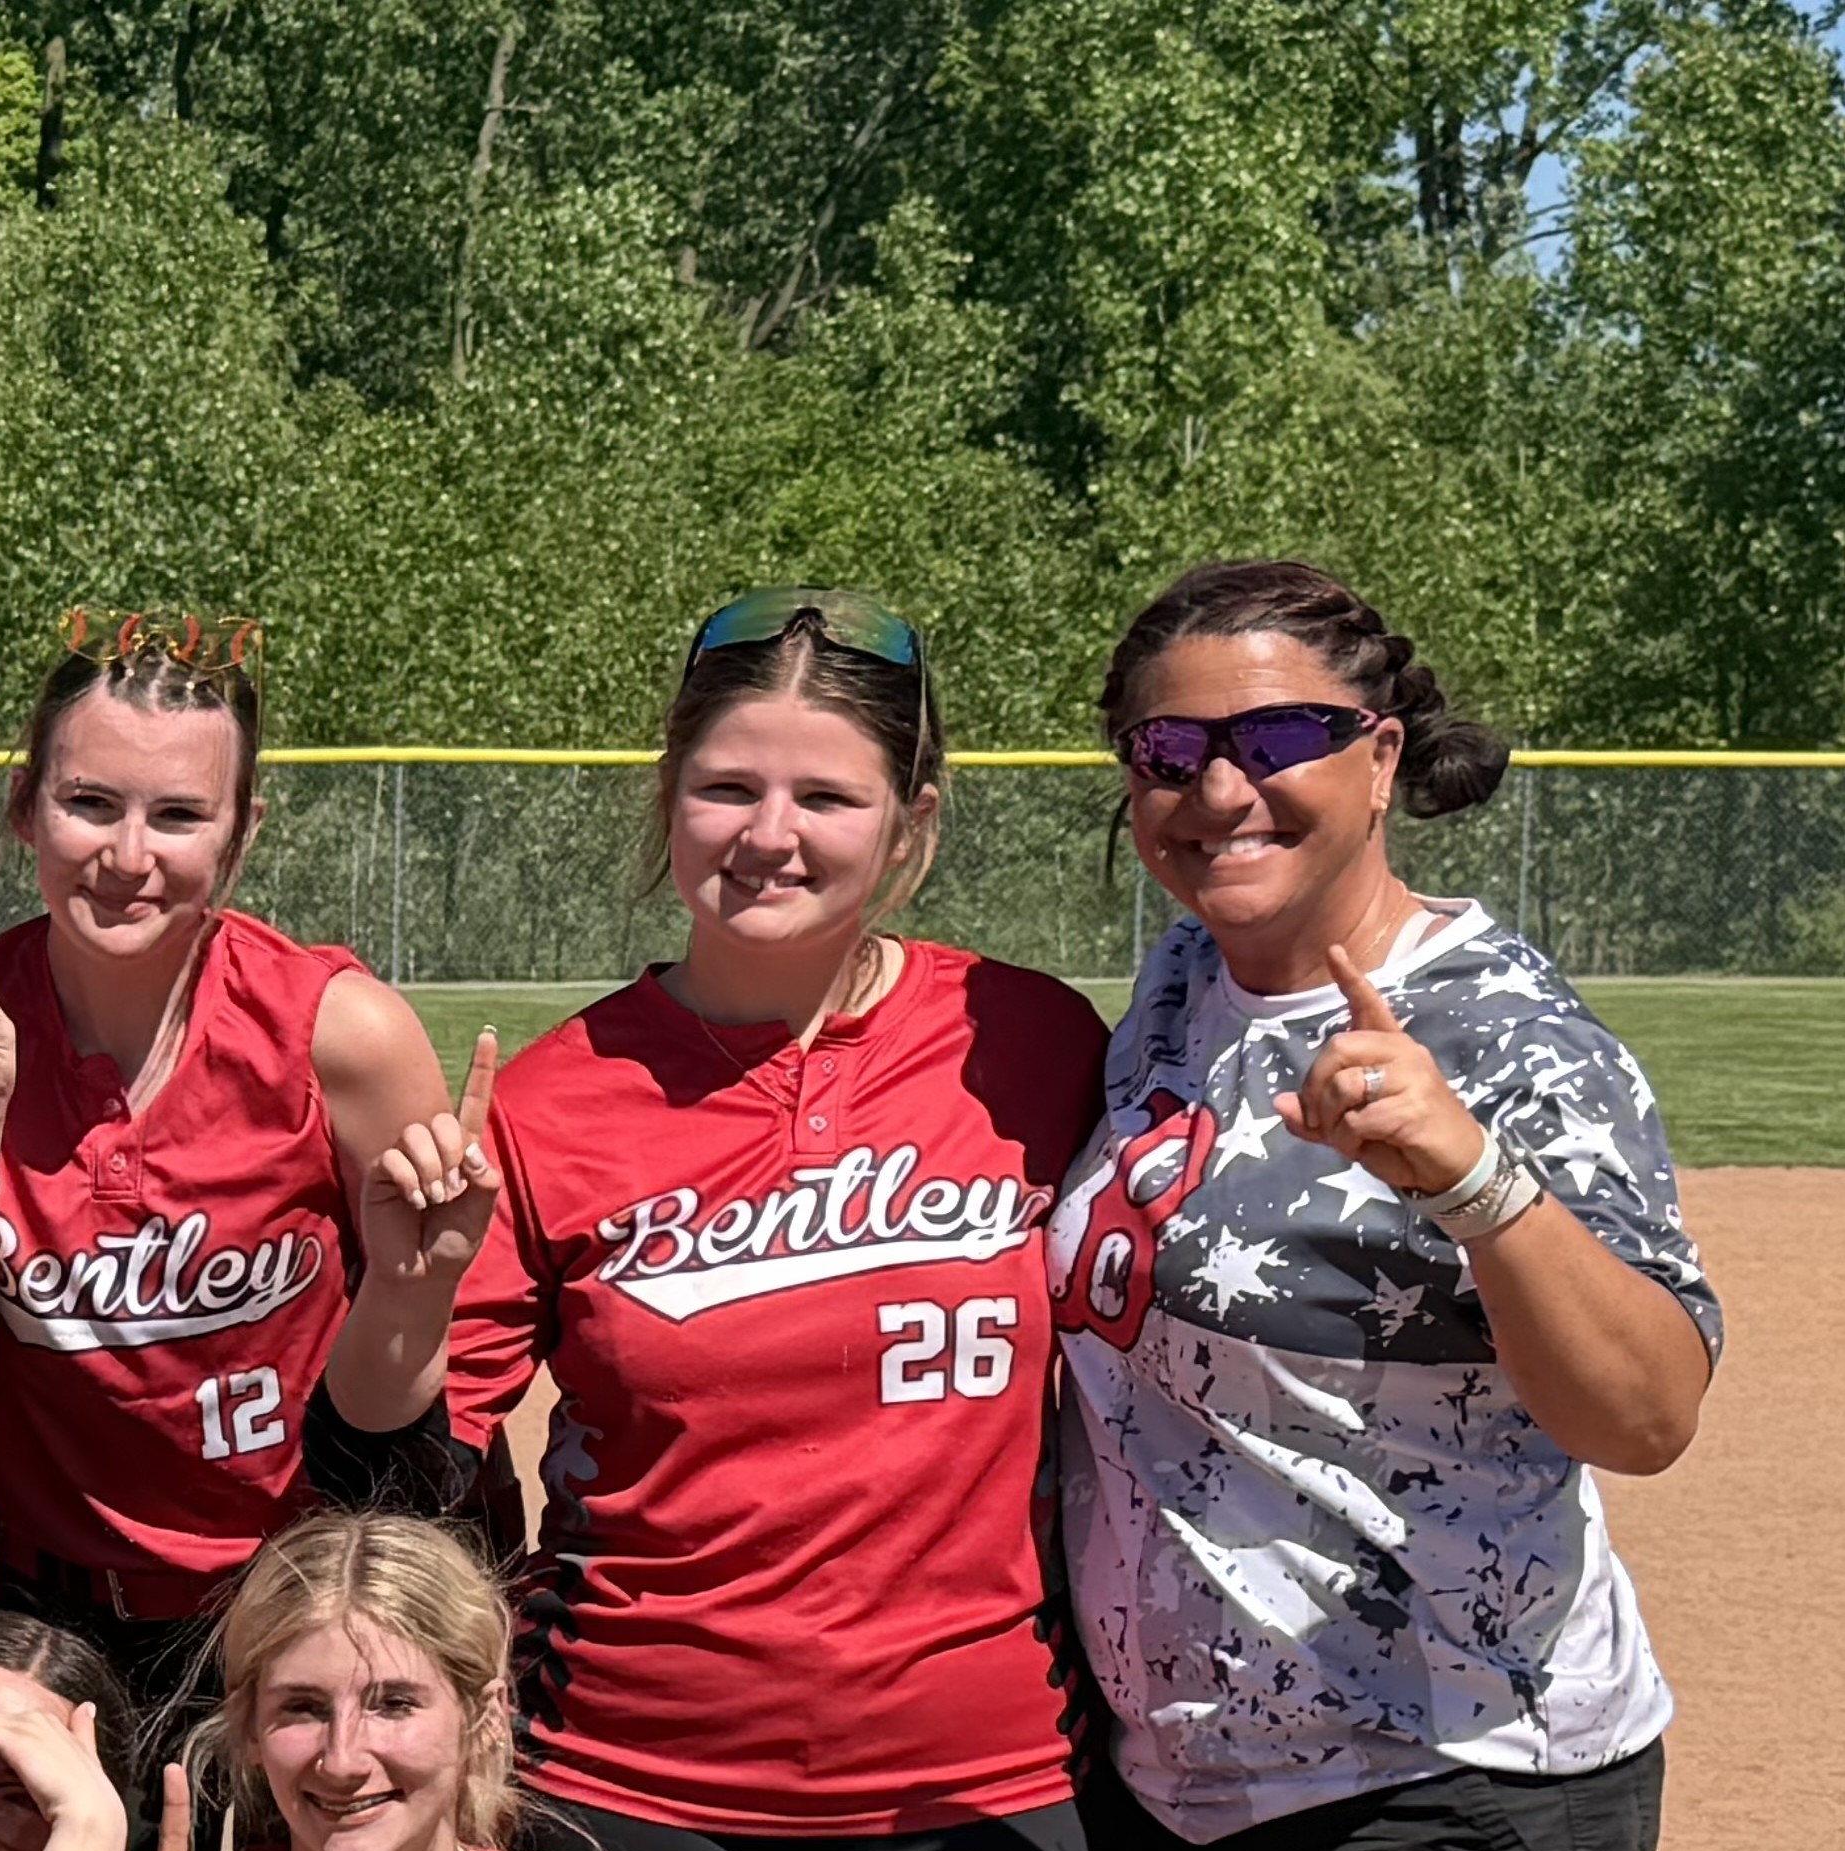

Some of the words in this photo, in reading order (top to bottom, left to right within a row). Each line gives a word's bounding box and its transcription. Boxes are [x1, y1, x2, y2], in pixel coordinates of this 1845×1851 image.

[597, 1145, 1053, 1283] Bentley
[878, 1297, 1018, 1404] 26
[196, 1366, 285, 1459] 12
